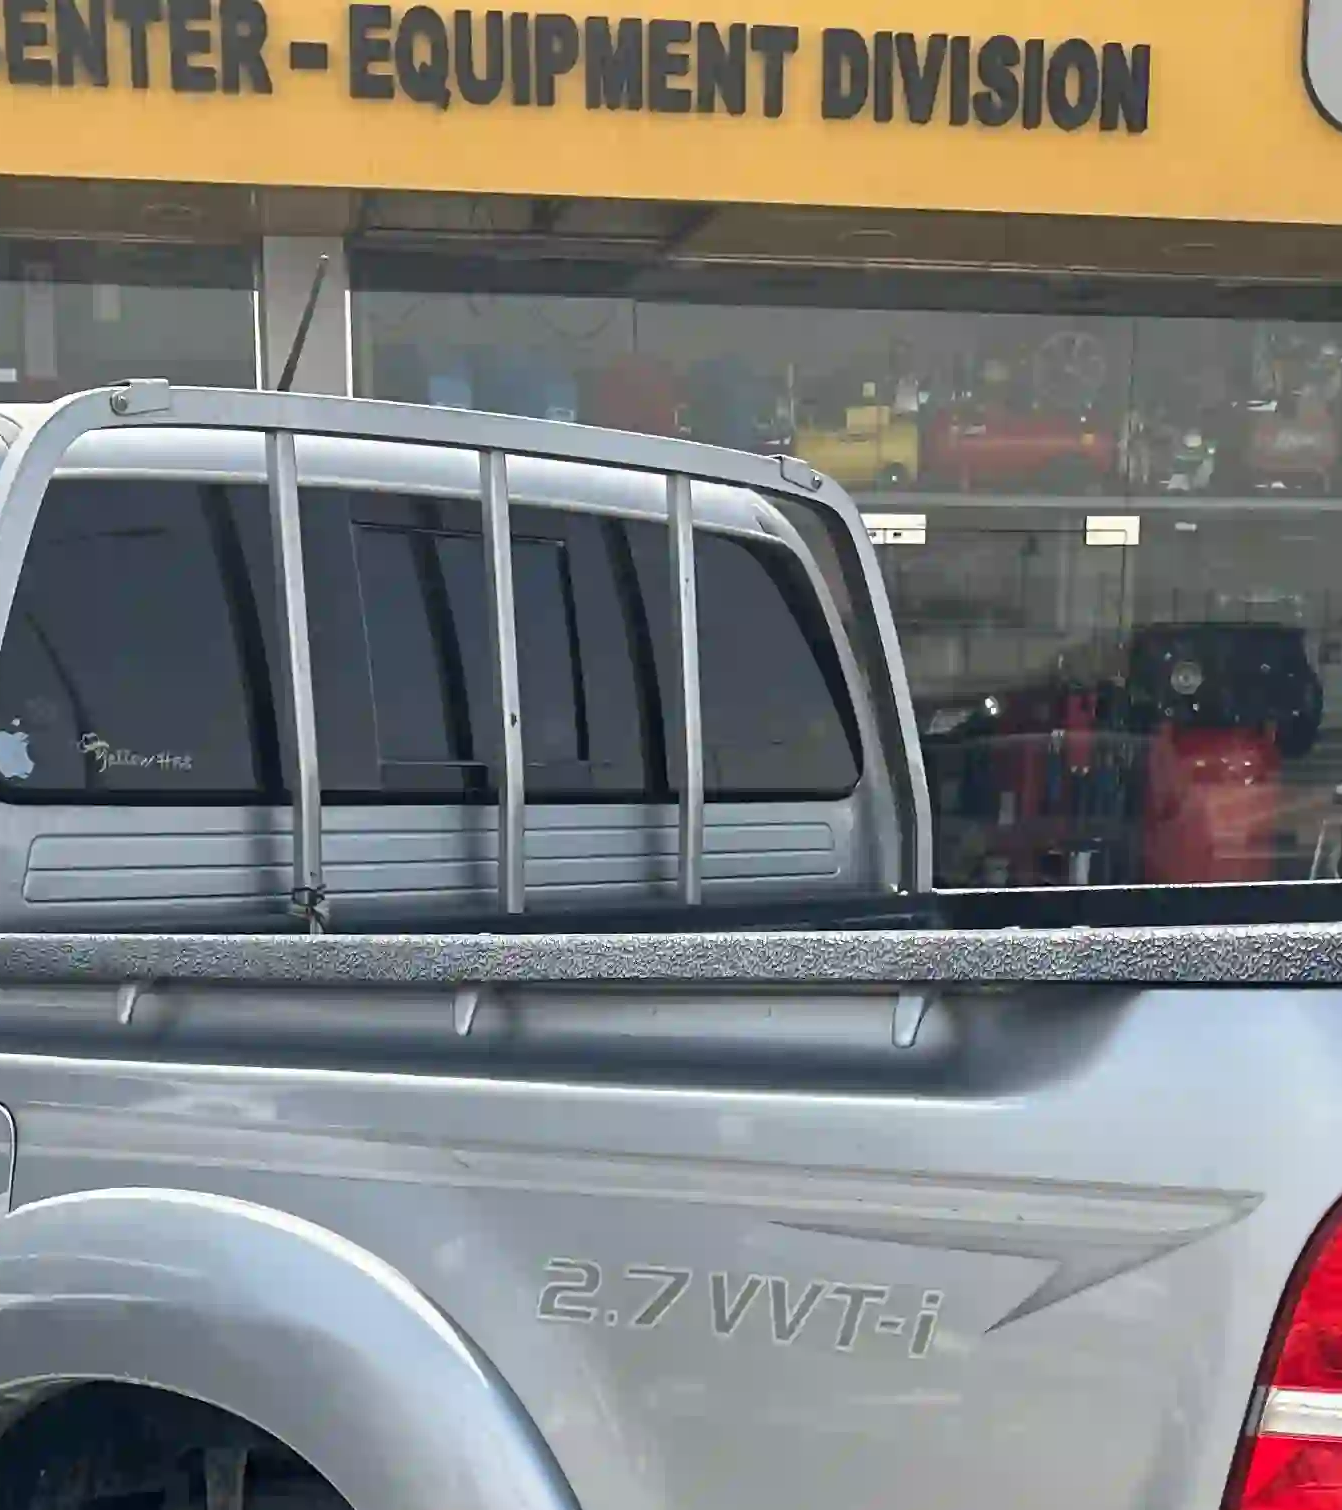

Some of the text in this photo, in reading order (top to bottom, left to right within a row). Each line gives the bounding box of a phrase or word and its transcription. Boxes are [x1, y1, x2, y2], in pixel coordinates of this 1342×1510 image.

[349, 4, 799, 118] EQUIPMENT
[821, 28, 1151, 133] DIVISION
[537, 1257, 945, 1359] 2.7 VVT-i
